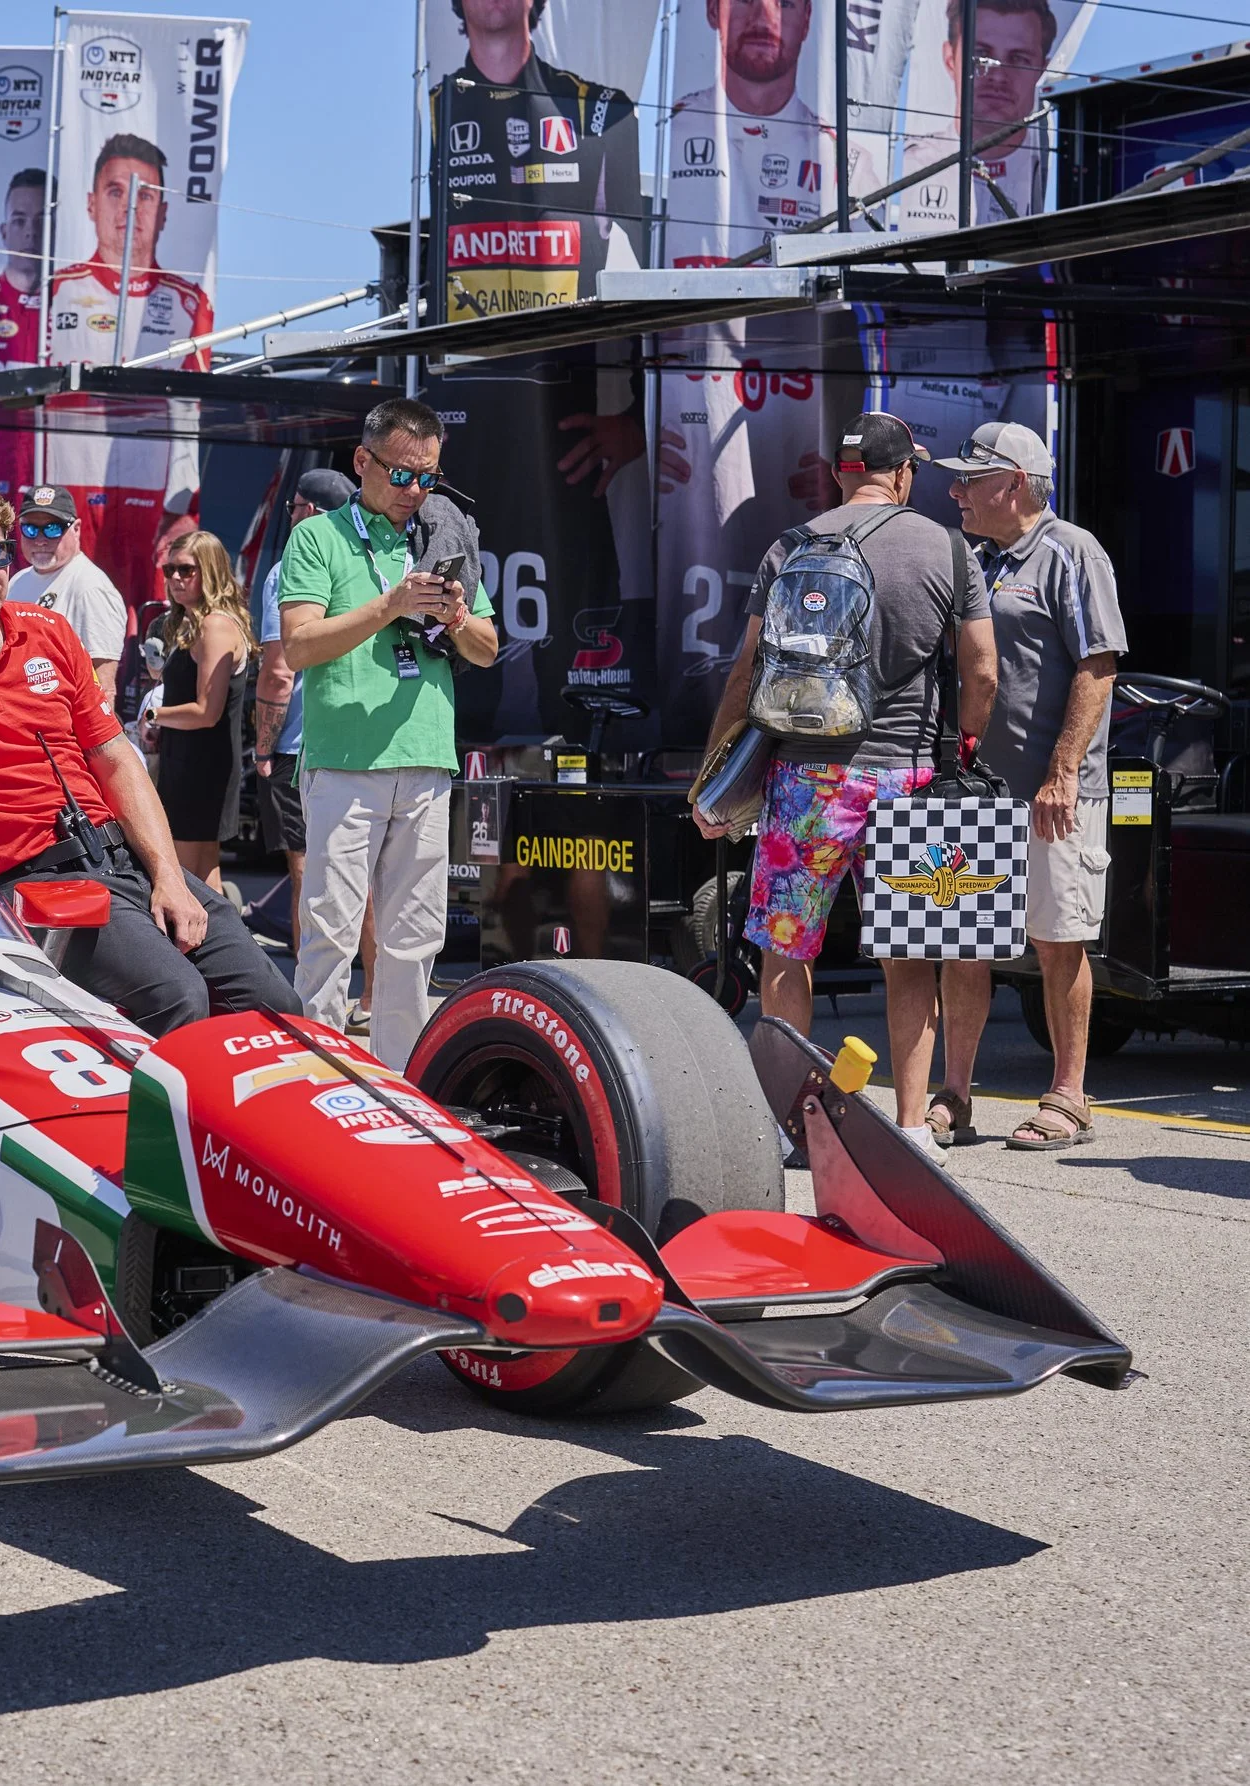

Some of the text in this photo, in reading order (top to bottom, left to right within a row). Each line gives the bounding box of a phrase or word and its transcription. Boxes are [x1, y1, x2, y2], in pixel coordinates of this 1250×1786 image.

[109, 50, 137, 63] NTT
[177, 38, 190, 94] WILL
[81, 69, 142, 84] INDYCAR
[13, 79, 38, 92] NTT
[186, 38, 225, 204] POWER
[450, 153, 494, 167] ONDA
[528, 168, 541, 179] 26
[672, 168, 726, 179] HONDA
[907, 211, 956, 221] HONDA
[452, 230, 574, 260] ANDRETTI
[951, 385, 959, 396] &
[435, 410, 467, 424] parco
[37, 661, 51, 670] NTT
[27, 670, 57, 684] INDYCAR
[1124, 815, 1140, 823] 2025
[472, 822, 488, 842] 26
[517, 835, 634, 873] GAINBRIDGE
[945, 871, 955, 903] MOTOR
[958, 881, 991, 889] SPEEDWAY
[223, 1030, 351, 1056] Cetar
[490, 990, 591, 1083] Firestone
[235, 1163, 342, 1252] MONOLITH
[528, 1259, 654, 1288] dallara
[448, 1348, 502, 1387] Fires
